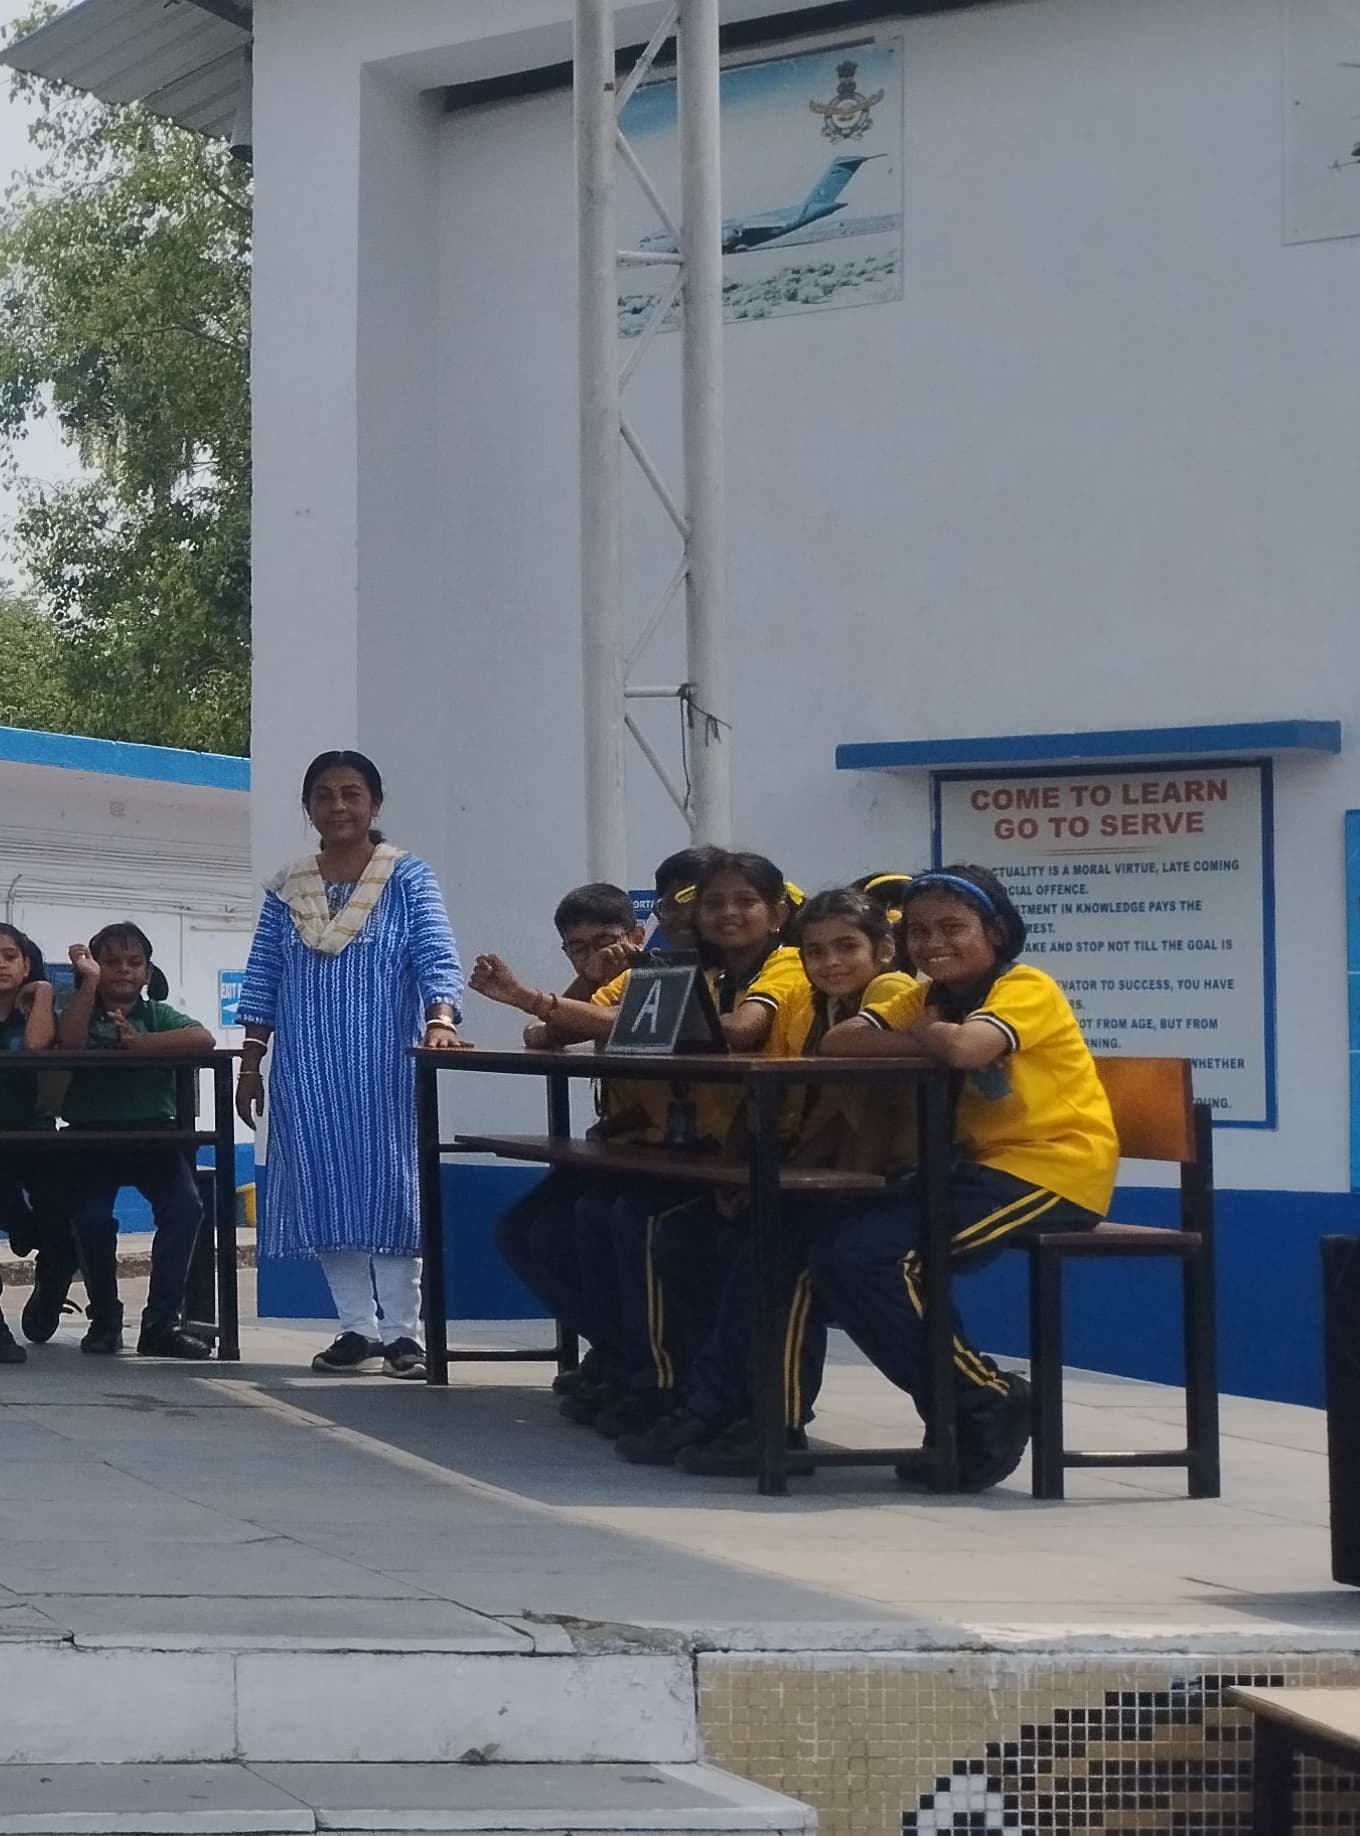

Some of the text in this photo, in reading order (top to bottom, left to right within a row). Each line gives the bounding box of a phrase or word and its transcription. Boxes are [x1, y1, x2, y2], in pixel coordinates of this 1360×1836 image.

[970, 779, 1228, 811] COME TO LEARN
[994, 811, 1204, 840] GO TO SERVE
[992, 859, 1239, 878] CTUALITY IS A MORAL VIRTUE, LATE COMING
[1036, 883, 1089, 896] OFFENCE.
[1017, 900, 1202, 915] TMENT IN KNOWLEDGE PAYS THE
[1025, 922, 1056, 934] REST.
[1024, 939, 1233, 953] AKE AND STOP NOT TILL THE GOAL IS
[1059, 978, 1234, 992] VATOR TO SUCCESS, YOU HAVE
[631, 979, 662, 1033] A
[1080, 1018, 1218, 1031] OT FROM AGE, BUT FROM
[1083, 1038, 1121, 1049] RNING.
[1191, 1058, 1245, 1069] WHETHER
[1194, 1097, 1232, 1109] OUNG.
